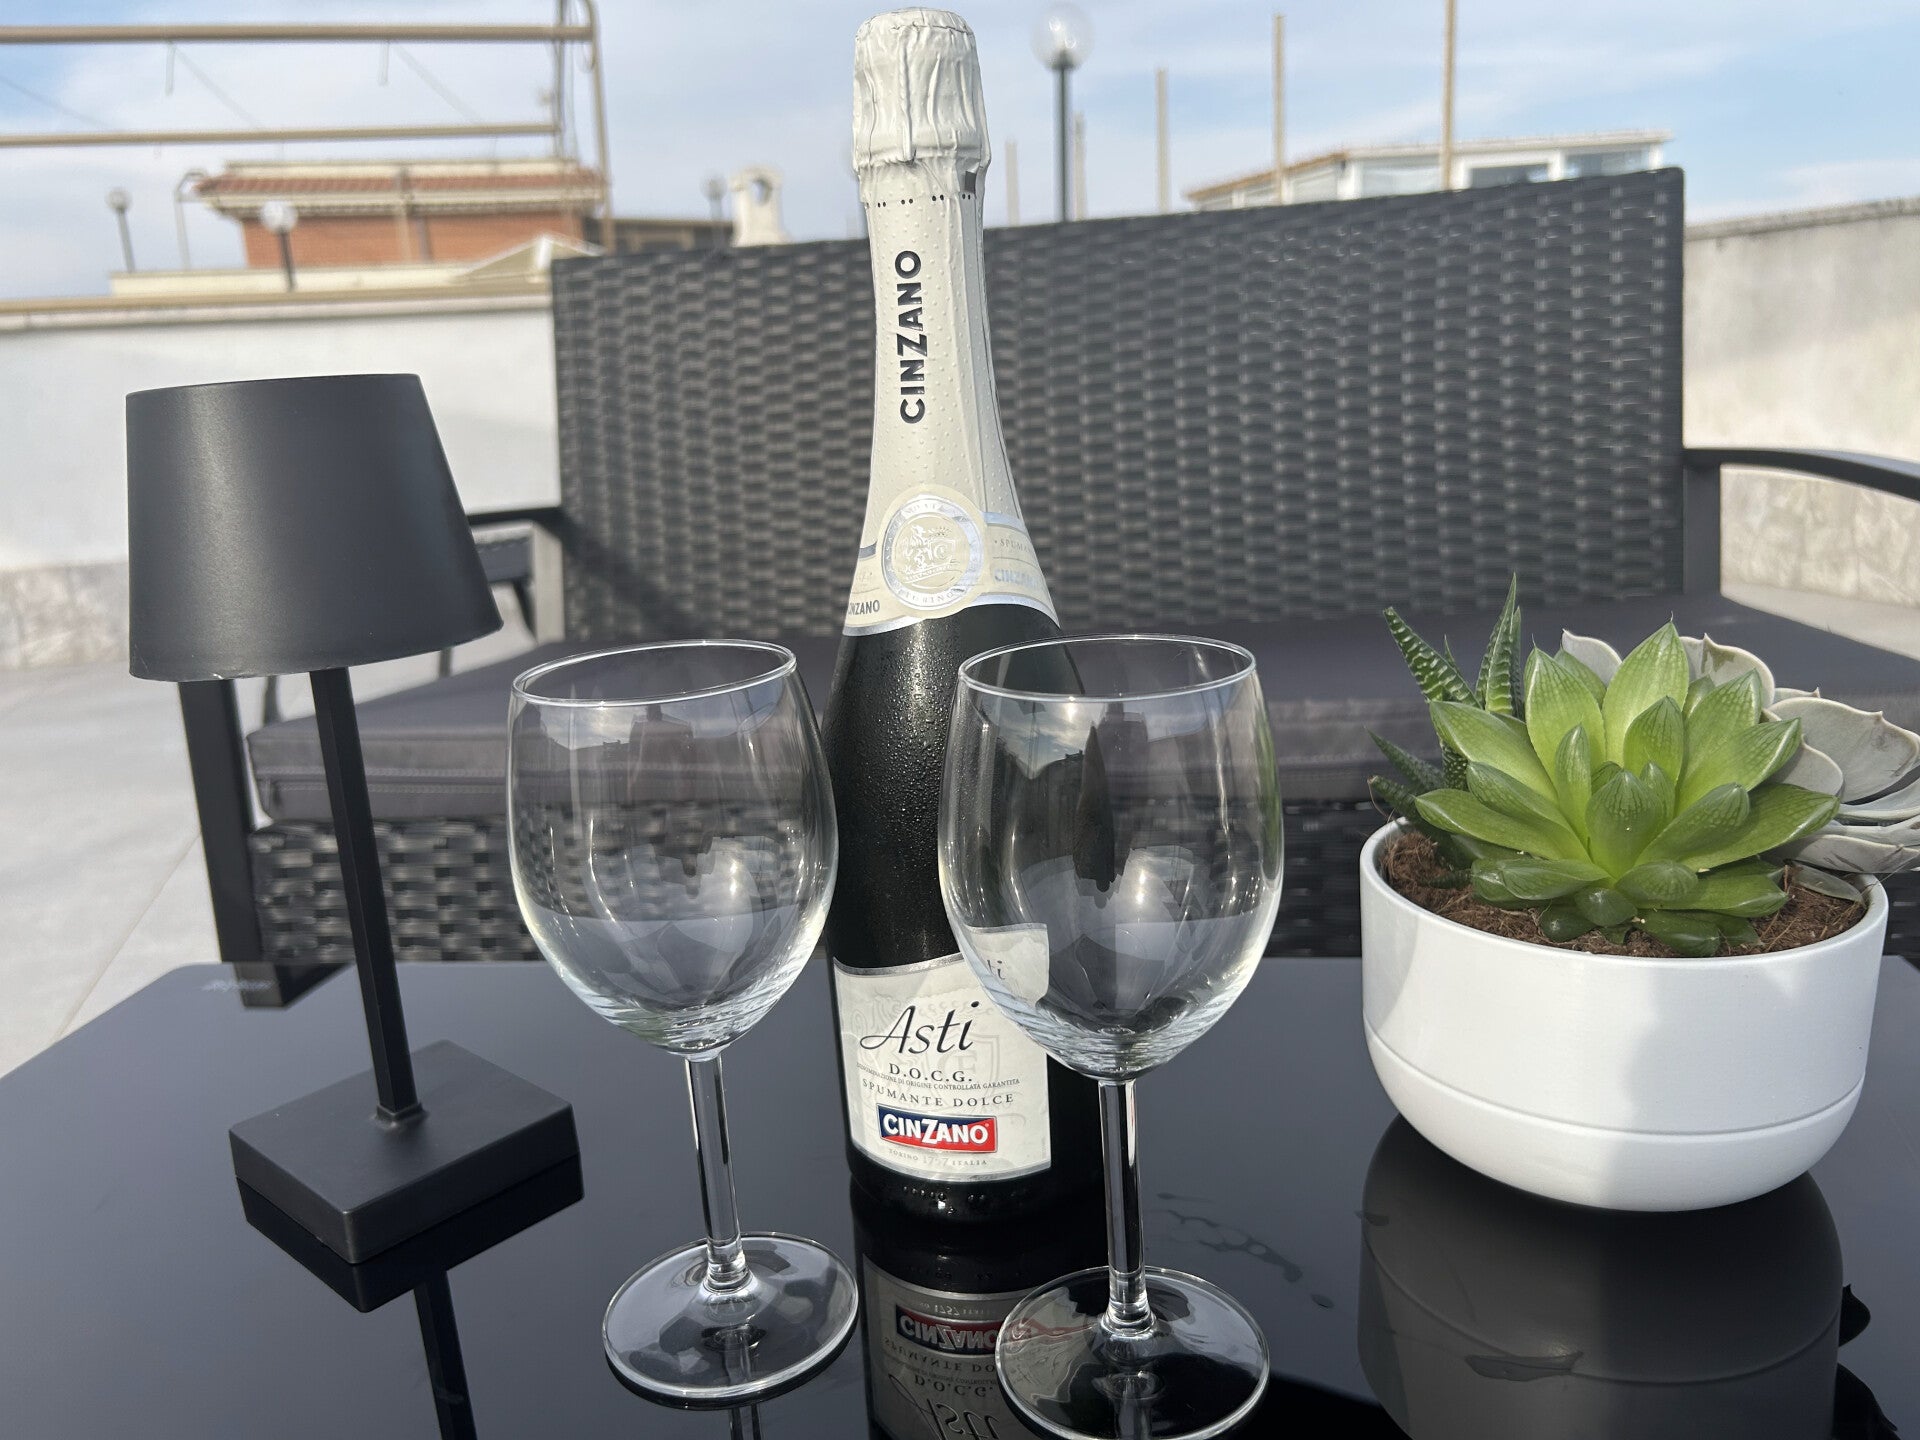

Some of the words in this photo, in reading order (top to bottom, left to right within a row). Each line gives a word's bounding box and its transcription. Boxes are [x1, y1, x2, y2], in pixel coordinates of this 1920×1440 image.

[894, 250, 928, 424] CINZANO
[859, 1000, 980, 1054] Asti
[889, 1062, 973, 1083] D.O.C.G.
[898, 1077, 905, 1085] DI
[906, 1079, 932, 1089] ORIGINE
[934, 1083, 981, 1091] CONTROLLATA
[983, 1078, 1020, 1090] GARANTITA
[862, 1078, 943, 1107] SPUMANTE
[953, 1093, 1014, 1107] DOLCE
[883, 1113, 989, 1145] CINZANO
